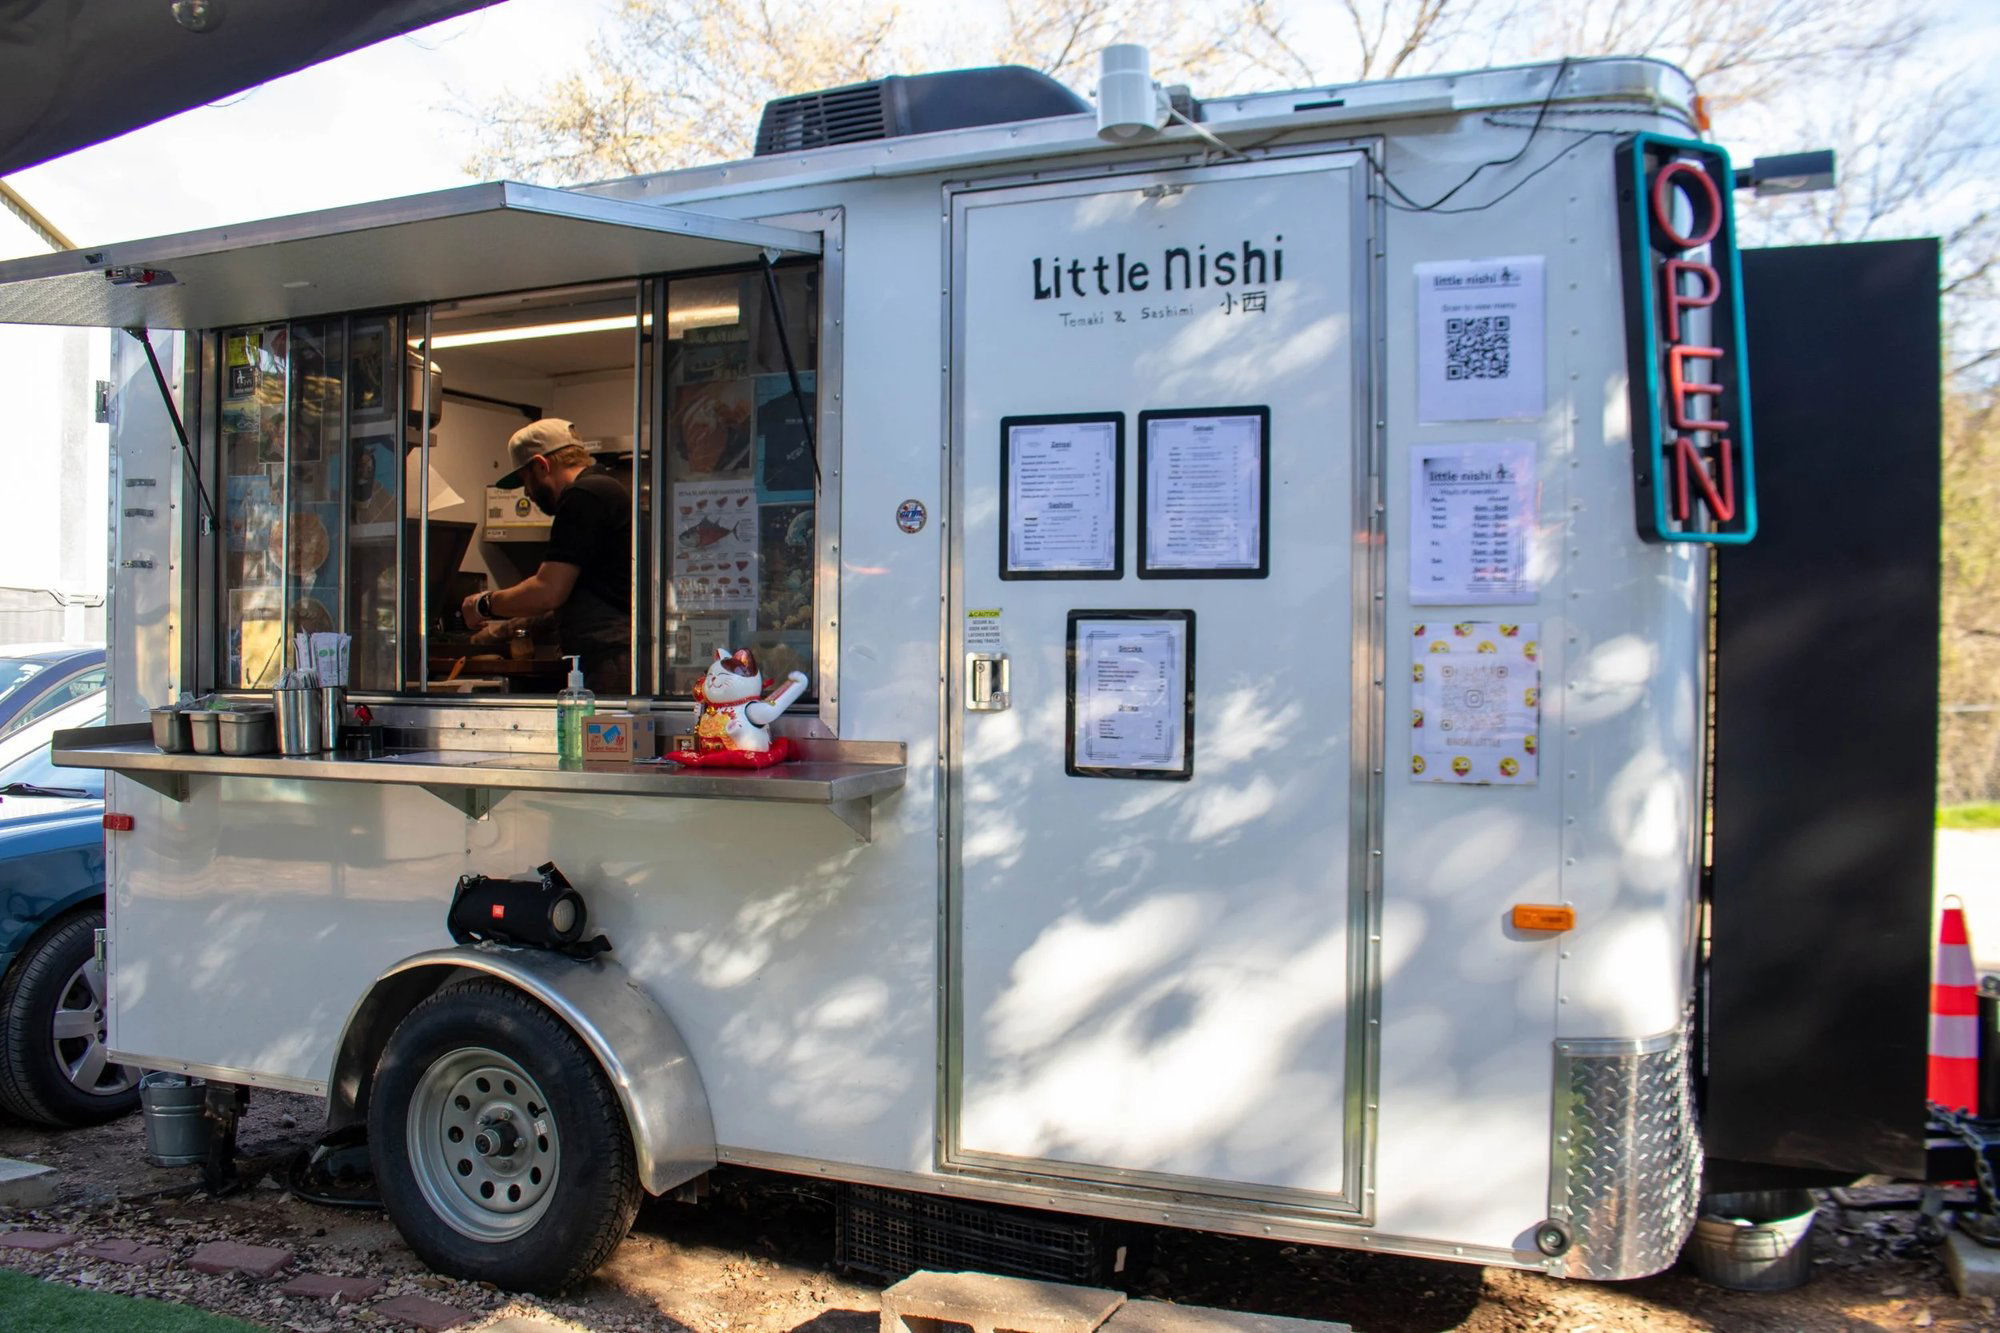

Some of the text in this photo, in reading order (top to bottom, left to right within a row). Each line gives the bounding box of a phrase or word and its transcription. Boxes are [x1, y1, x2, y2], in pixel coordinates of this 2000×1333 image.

[1033, 252, 1149, 300] Little
[1113, 309, 1126, 323] &
[1141, 304, 1194, 320] Sashimi
[1219, 290, 1267, 315] 小西
[1653, 163, 1734, 521] OPEN
